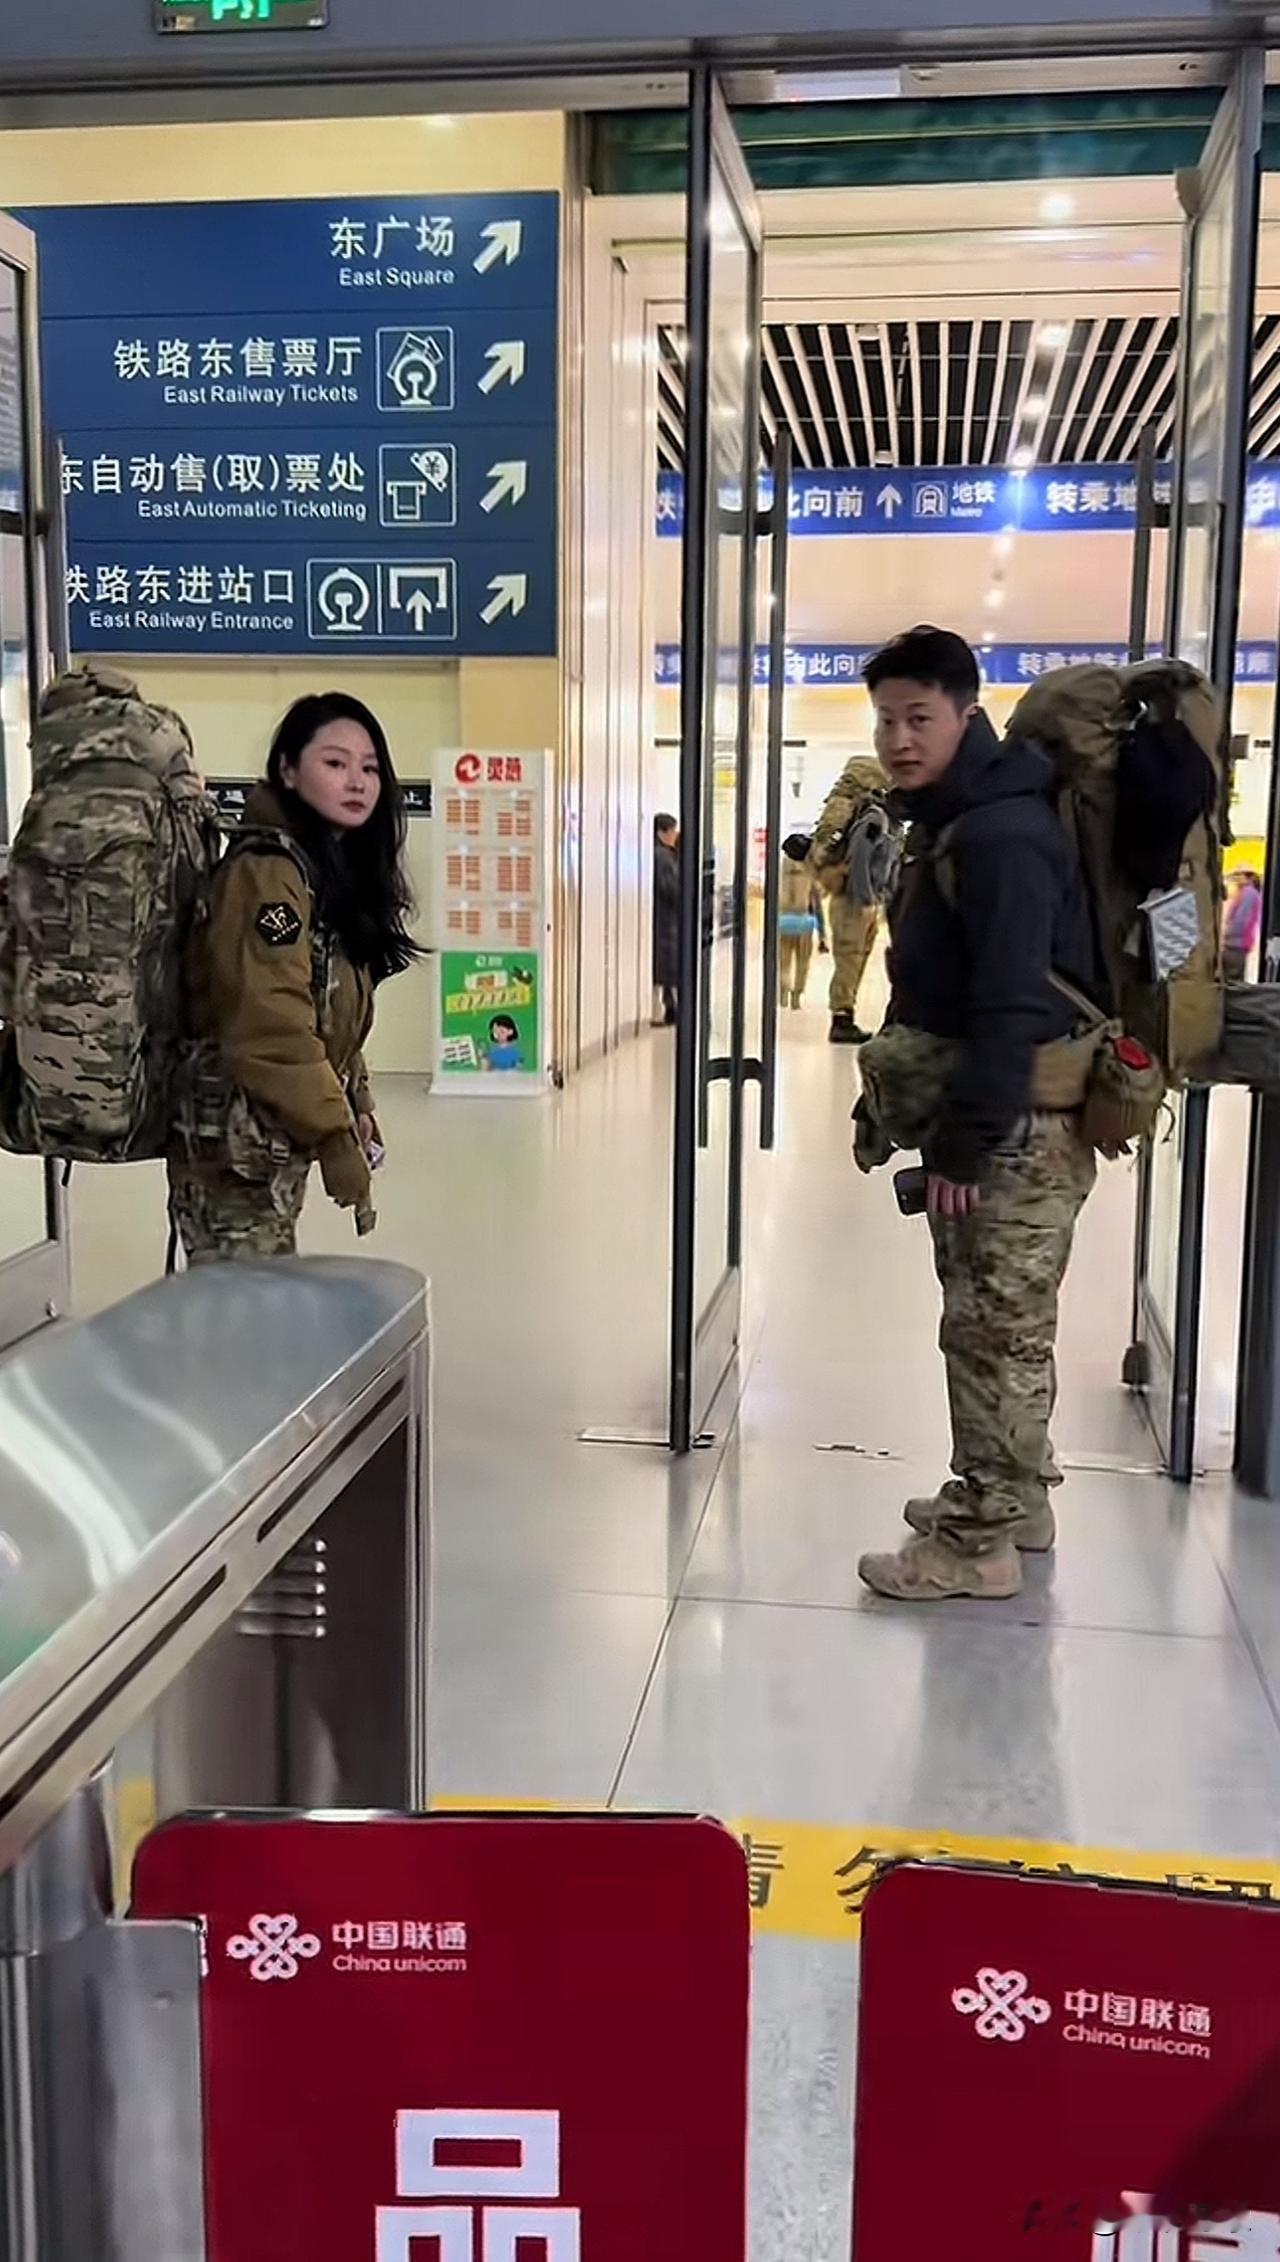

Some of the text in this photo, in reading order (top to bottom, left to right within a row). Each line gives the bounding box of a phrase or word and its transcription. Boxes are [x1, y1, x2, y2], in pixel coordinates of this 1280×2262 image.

[329, 214, 454, 259] 东广场
[340, 267, 455, 288] East Square
[113, 337, 362, 379] 铁路东售票厅
[164, 383, 358, 408] East Railway Tickets
[951, 480, 996, 503] 地铁
[138, 499, 367, 522] East Automatic Ticketing
[89, 611, 294, 632] East Railway Entrance
[332, 1919, 467, 1951] 中国联通
[332, 1952, 467, 1972] China unicom
[1064, 1988, 1212, 2037] 中国联通
[1062, 2023, 1210, 2060] China unicom
